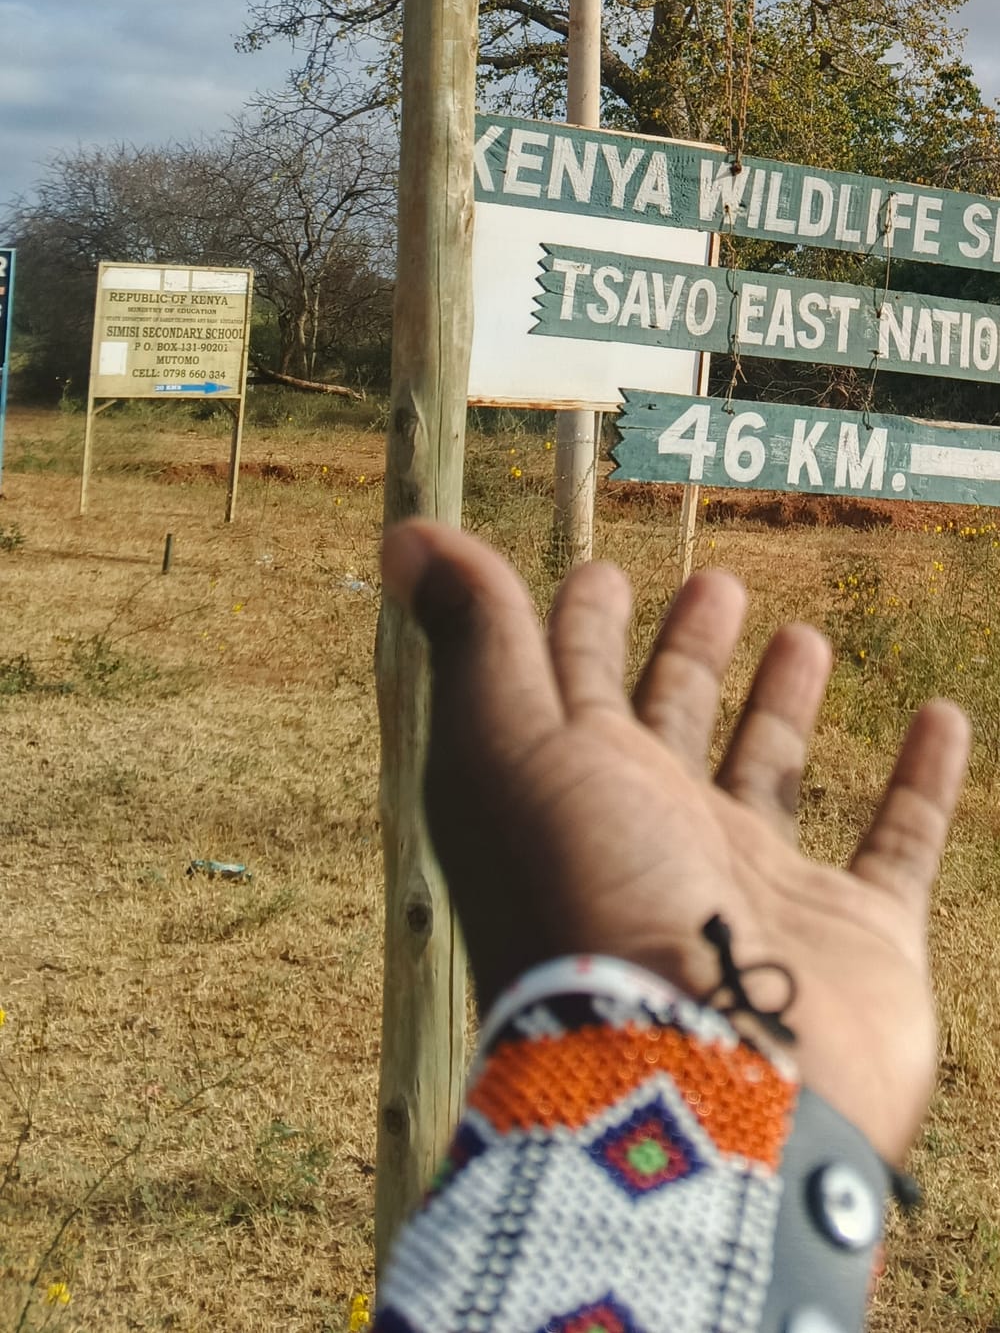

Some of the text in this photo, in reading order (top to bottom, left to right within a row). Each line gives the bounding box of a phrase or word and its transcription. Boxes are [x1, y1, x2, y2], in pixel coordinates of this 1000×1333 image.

[473, 125, 673, 216] KENYA
[699, 158, 943, 255] WILDLIFE
[109, 292, 228, 306] REPUBLIC OF KENYA
[552, 258, 718, 337] TSAVO
[736, 284, 861, 354] EAST
[176, 307, 217, 315] EDUCATION
[106, 325, 244, 340] SIMISI SECONDARY SCHOOL
[156, 355, 200, 365] MUTOMO
[132, 368, 226, 379] CELL: 0798 660 334
[657, 404, 907, 492] 46 KM.
